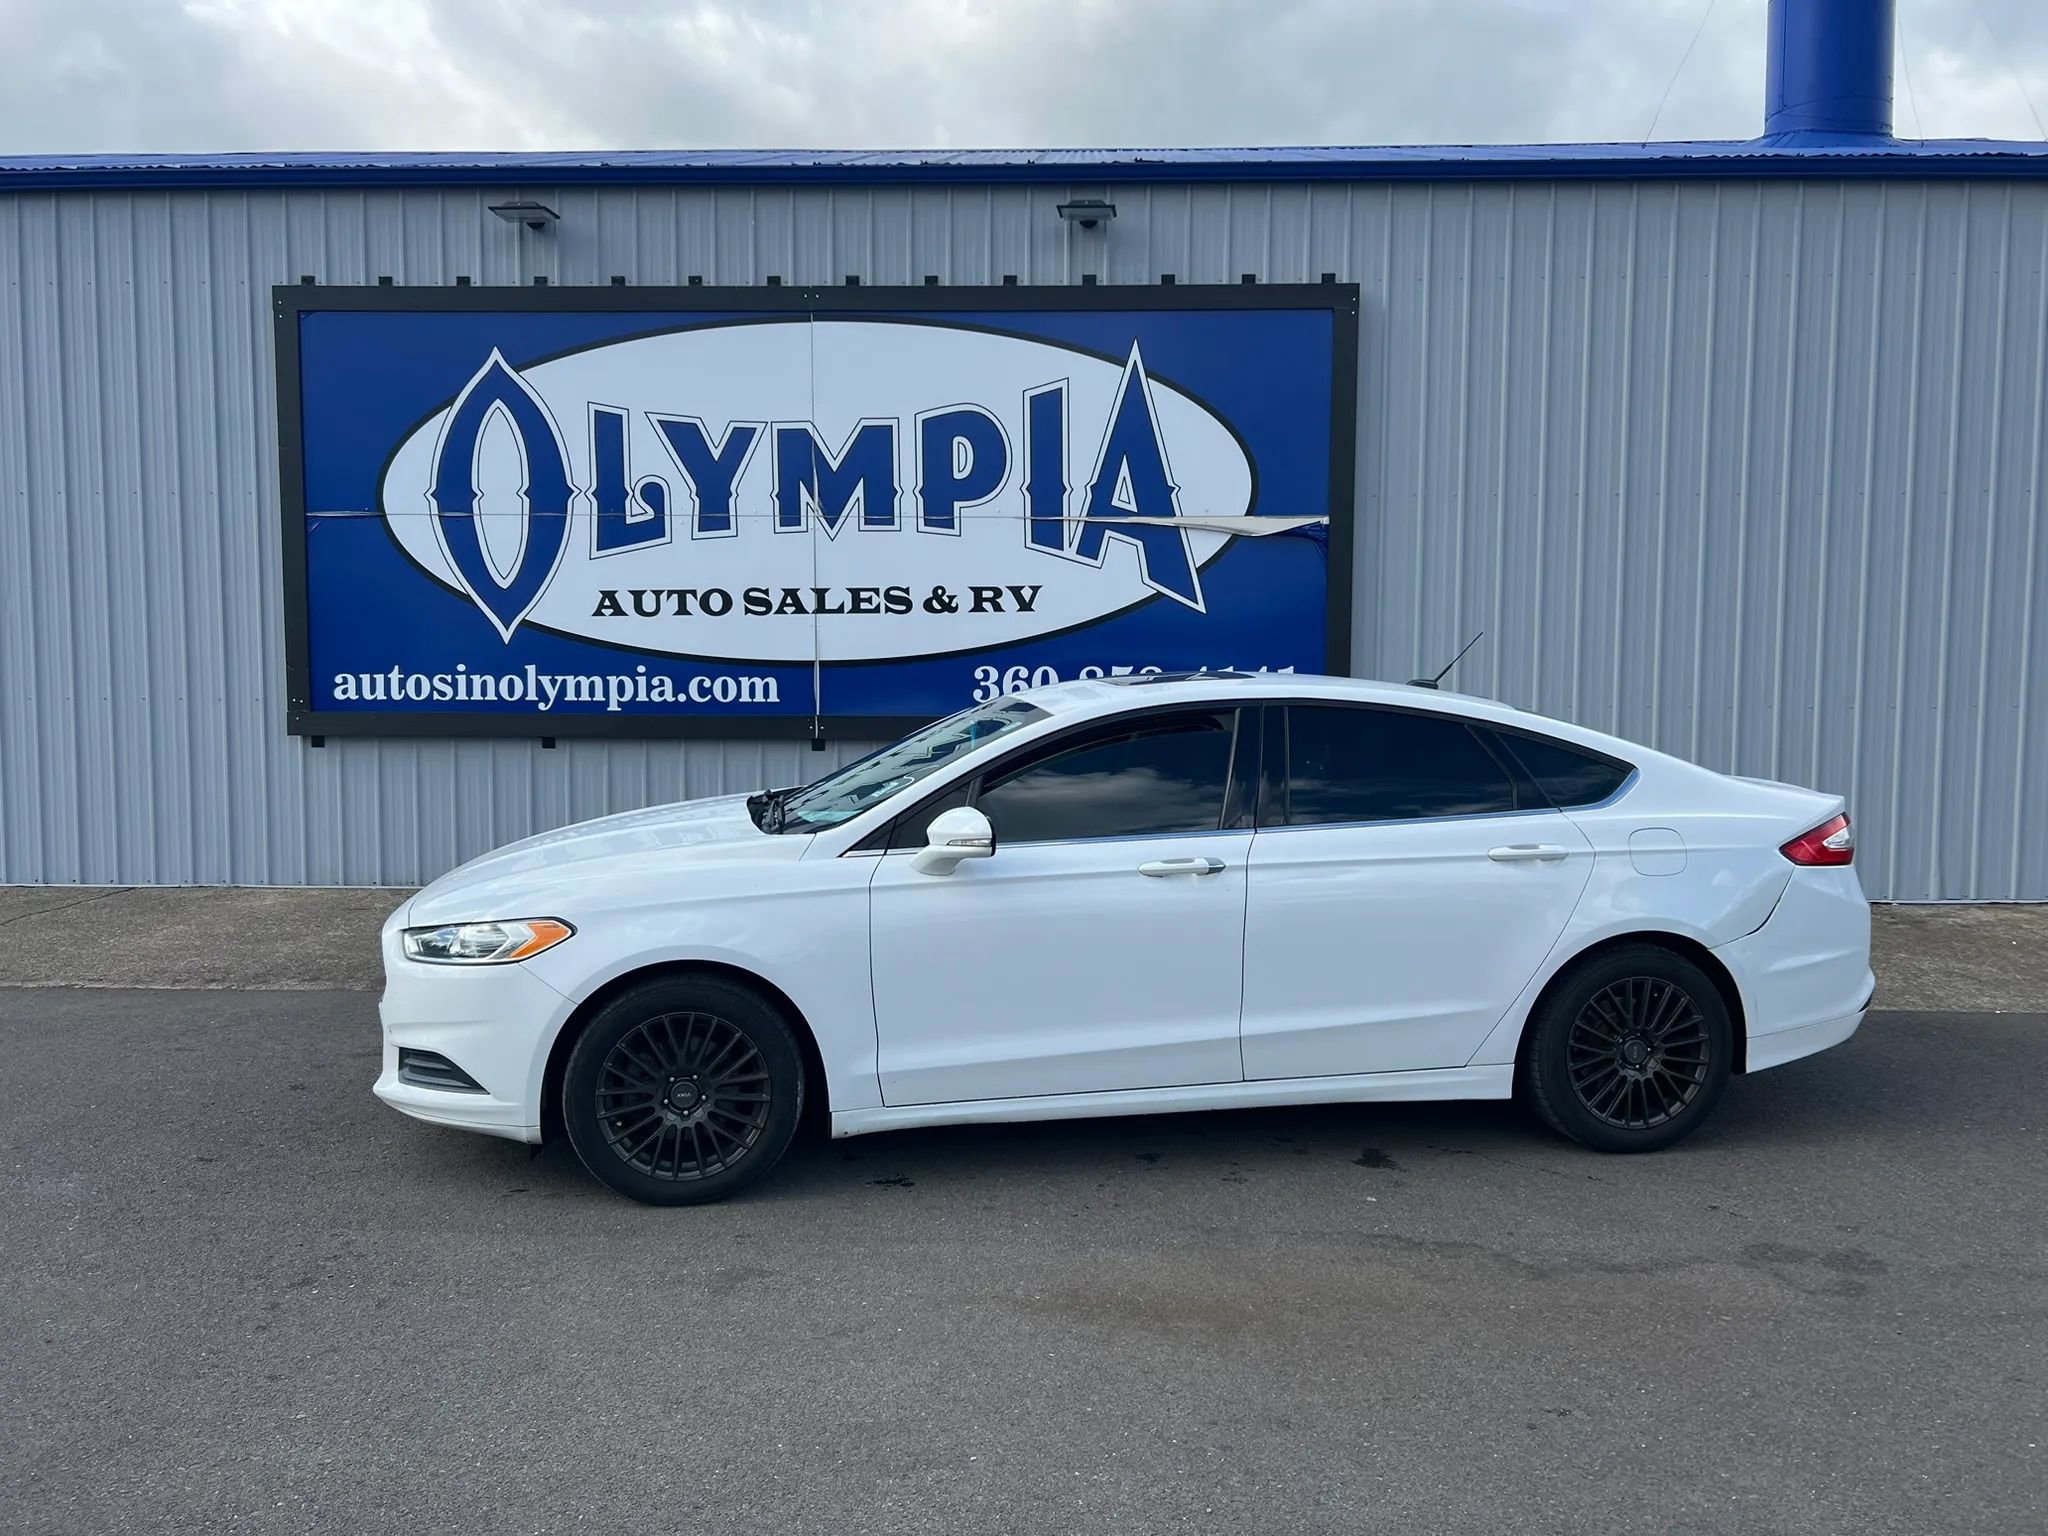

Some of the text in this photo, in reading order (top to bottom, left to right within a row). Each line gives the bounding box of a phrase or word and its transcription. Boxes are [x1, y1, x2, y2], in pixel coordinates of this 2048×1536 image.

[424, 337, 1207, 644] OLYMPIA
[591, 584, 1044, 618] AUTO SALES & RV
[333, 663, 780, 711] autosinolympia.com
